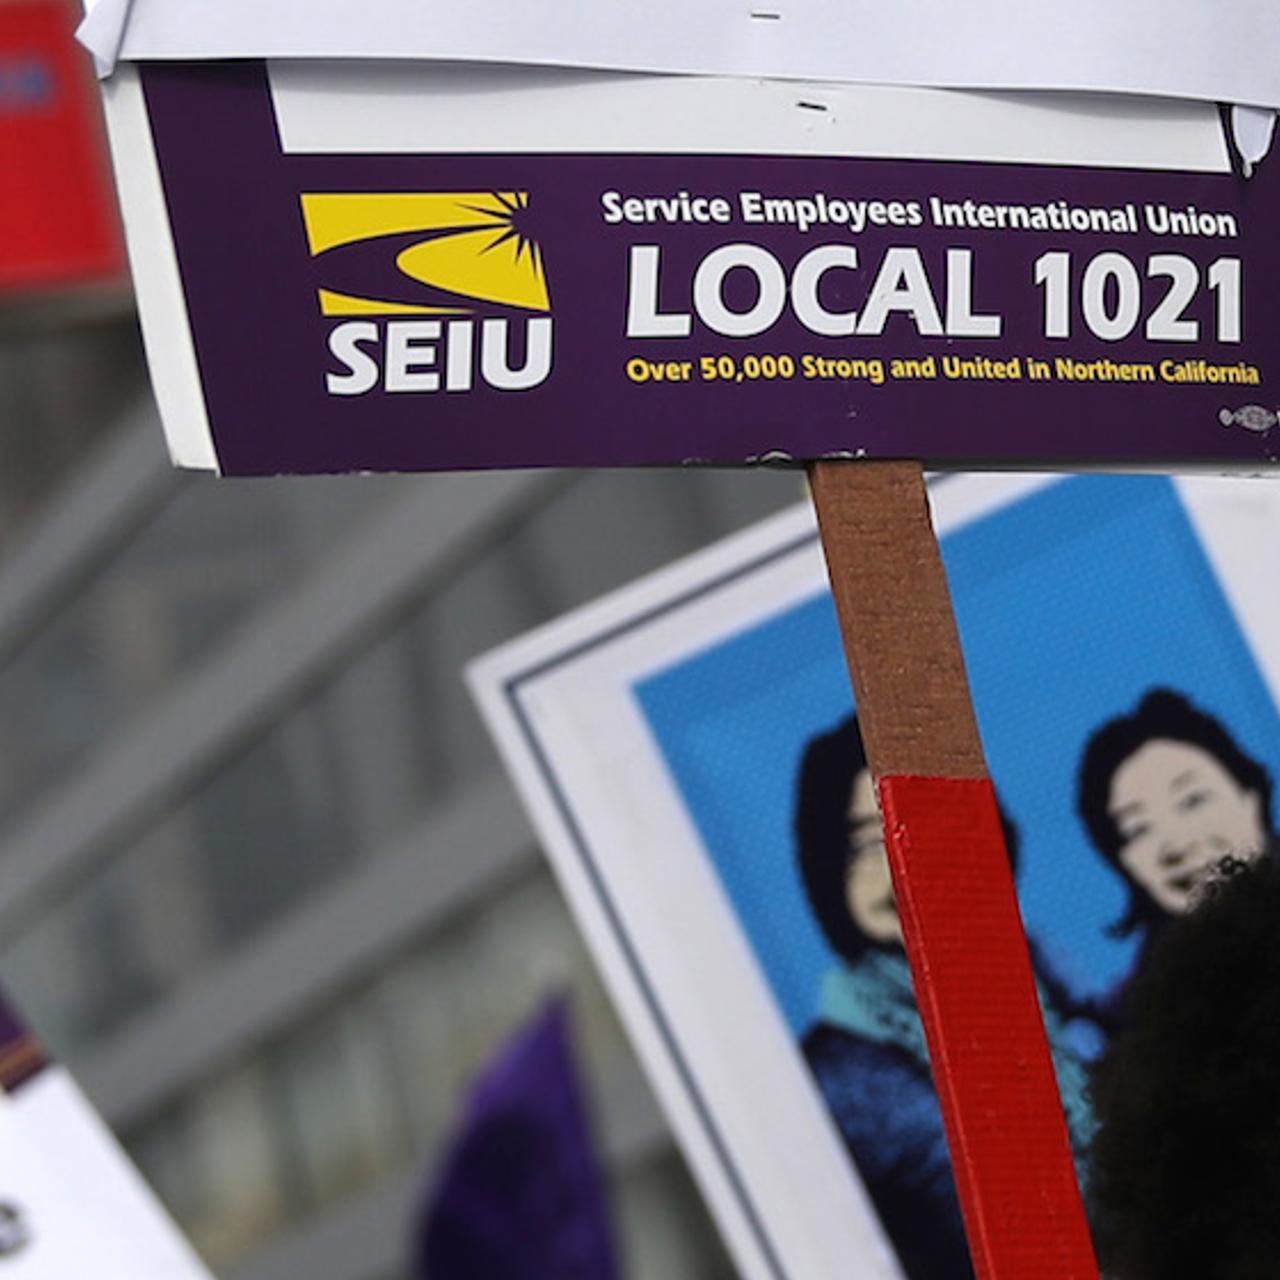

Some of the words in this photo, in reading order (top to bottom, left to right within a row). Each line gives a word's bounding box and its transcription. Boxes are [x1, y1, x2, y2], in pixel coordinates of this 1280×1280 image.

[601, 191, 730, 223] Service
[739, 192, 922, 232] Employees
[930, 198, 1138, 232] International
[1144, 205, 1237, 236] Union
[627, 244, 1001, 337] LOCAL
[1035, 251, 1241, 342] 1021
[326, 318, 553, 395] SEIU
[626, 358, 692, 381] Over
[700, 355, 794, 382] 50,000
[802, 355, 883, 383] Strong
[891, 357, 935, 378] and
[943, 357, 1020, 380] United
[1027, 357, 1050, 380] in
[1056, 359, 1155, 381] Northern
[1160, 360, 1260, 384] California
